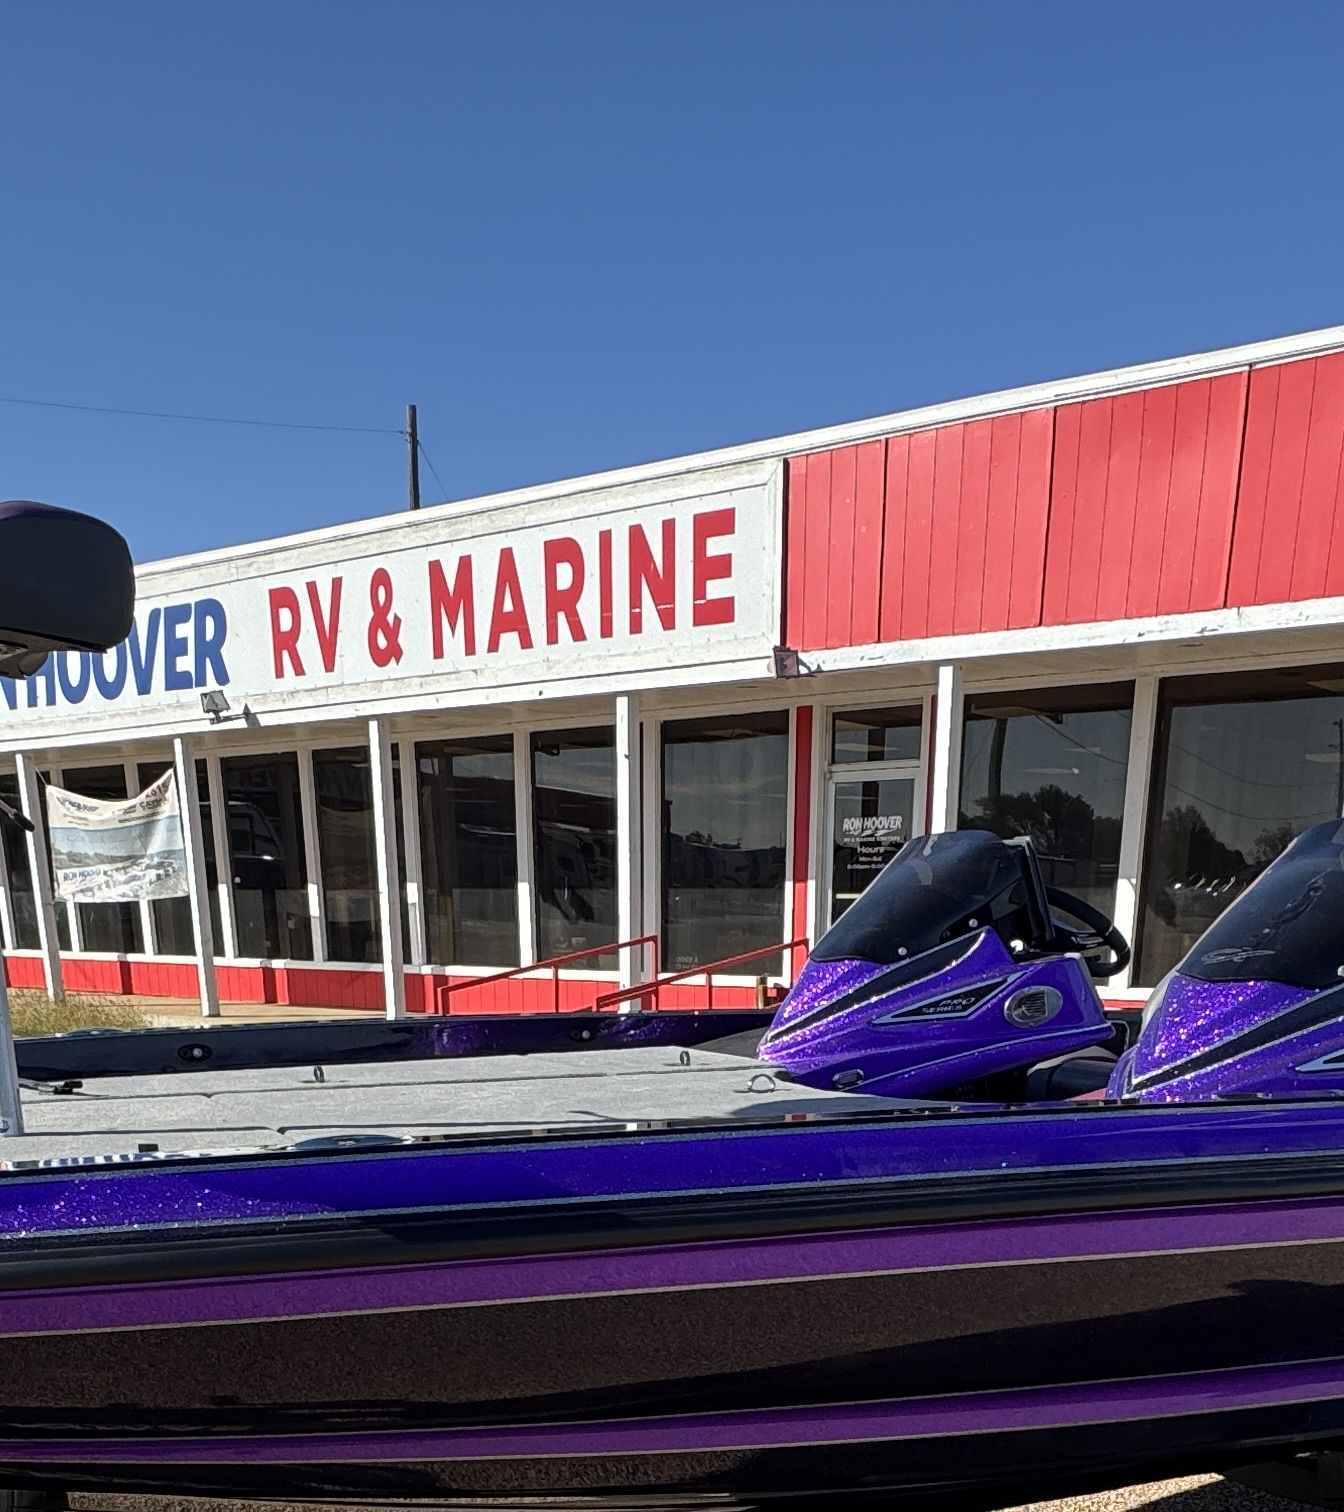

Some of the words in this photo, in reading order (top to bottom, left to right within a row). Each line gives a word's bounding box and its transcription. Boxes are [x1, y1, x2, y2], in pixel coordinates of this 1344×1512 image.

[268, 576, 344, 679] RV
[367, 567, 404, 668] &
[428, 507, 736, 660] MARINE
[843, 818, 862, 832] RON
[864, 816, 903, 829] HOOVER
